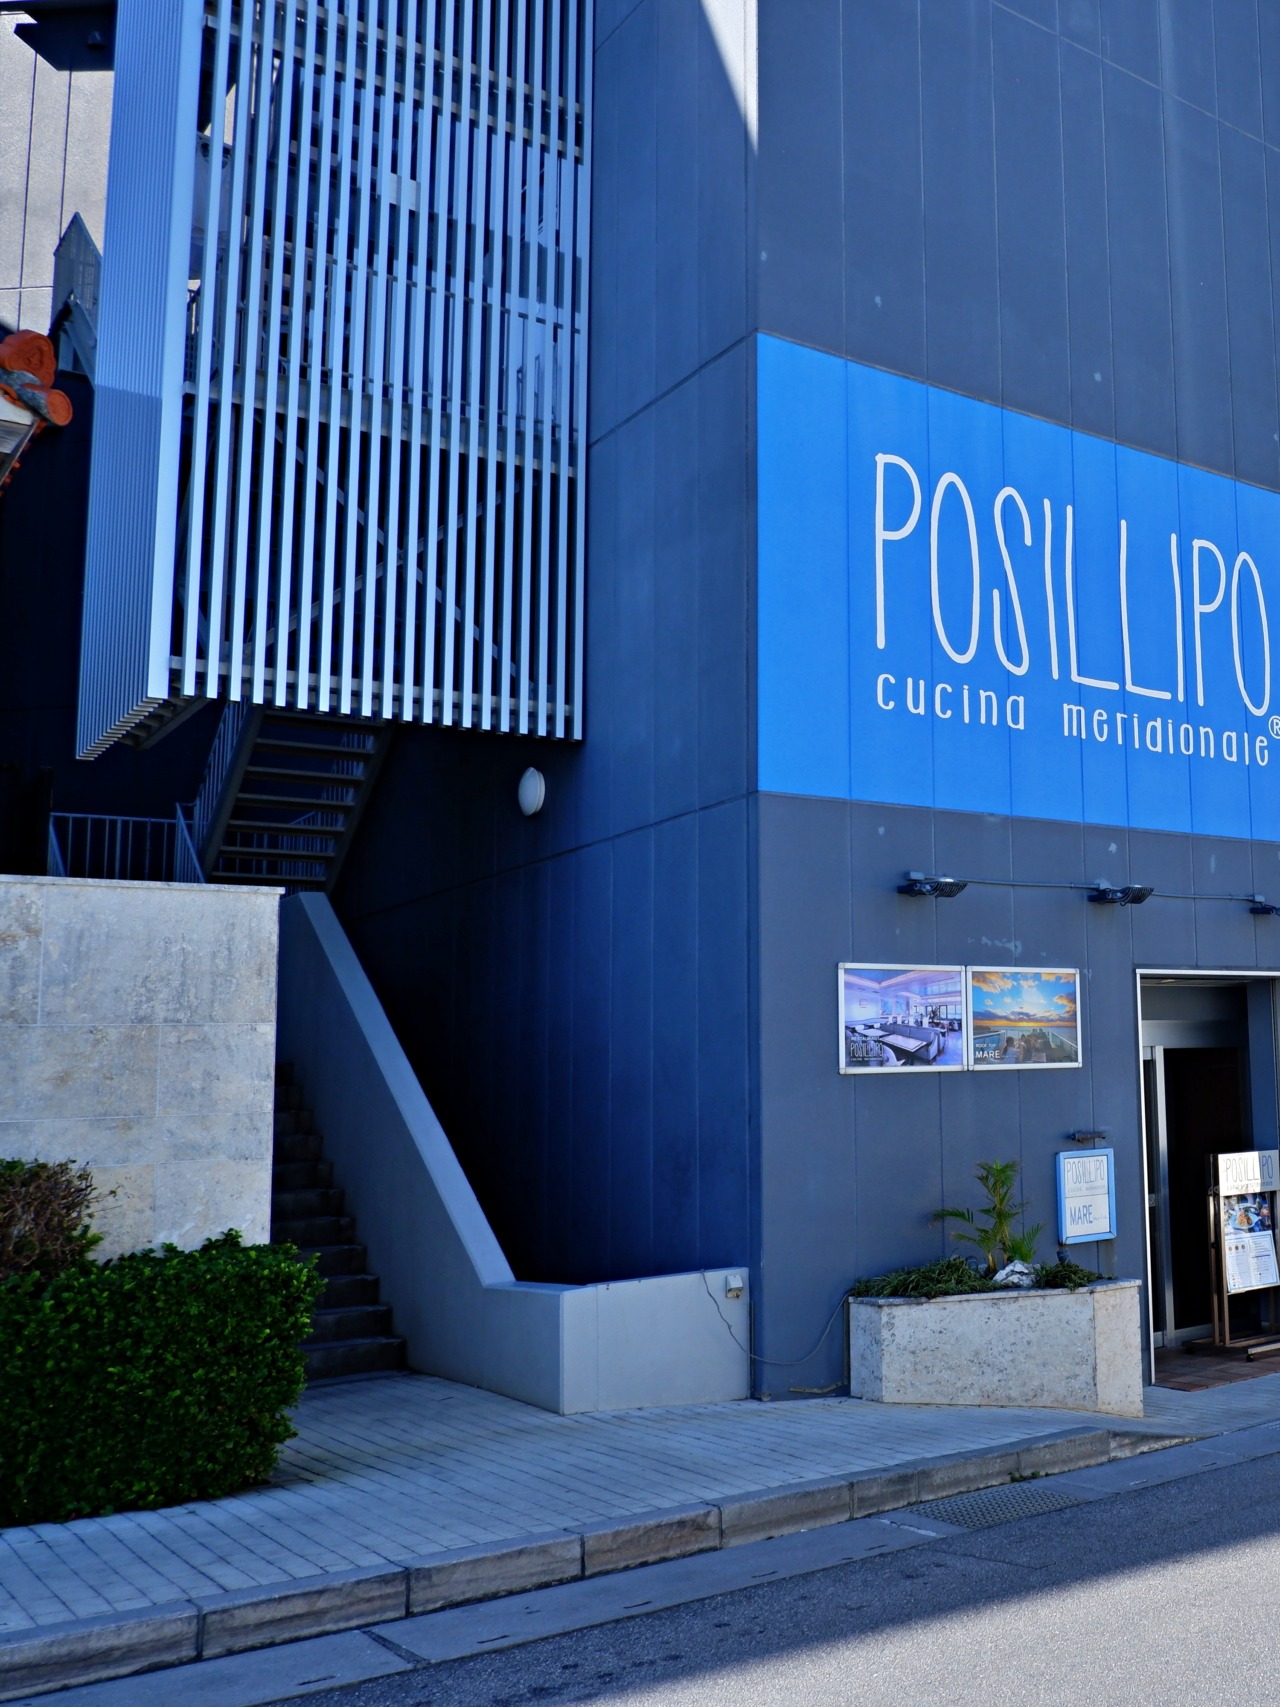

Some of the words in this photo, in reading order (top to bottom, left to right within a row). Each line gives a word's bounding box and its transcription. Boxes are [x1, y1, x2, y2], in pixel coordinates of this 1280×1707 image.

[875, 452, 1271, 716] POSILLIPO
[876, 673, 1025, 731] cucina
[1063, 702, 1270, 767] meridionale
[975, 1050, 1001, 1059] MARE
[1066, 1159, 1105, 1186] POSILLIPO
[1225, 1154, 1274, 1184] POSILLIPO
[1069, 1204, 1094, 1227] MARE
